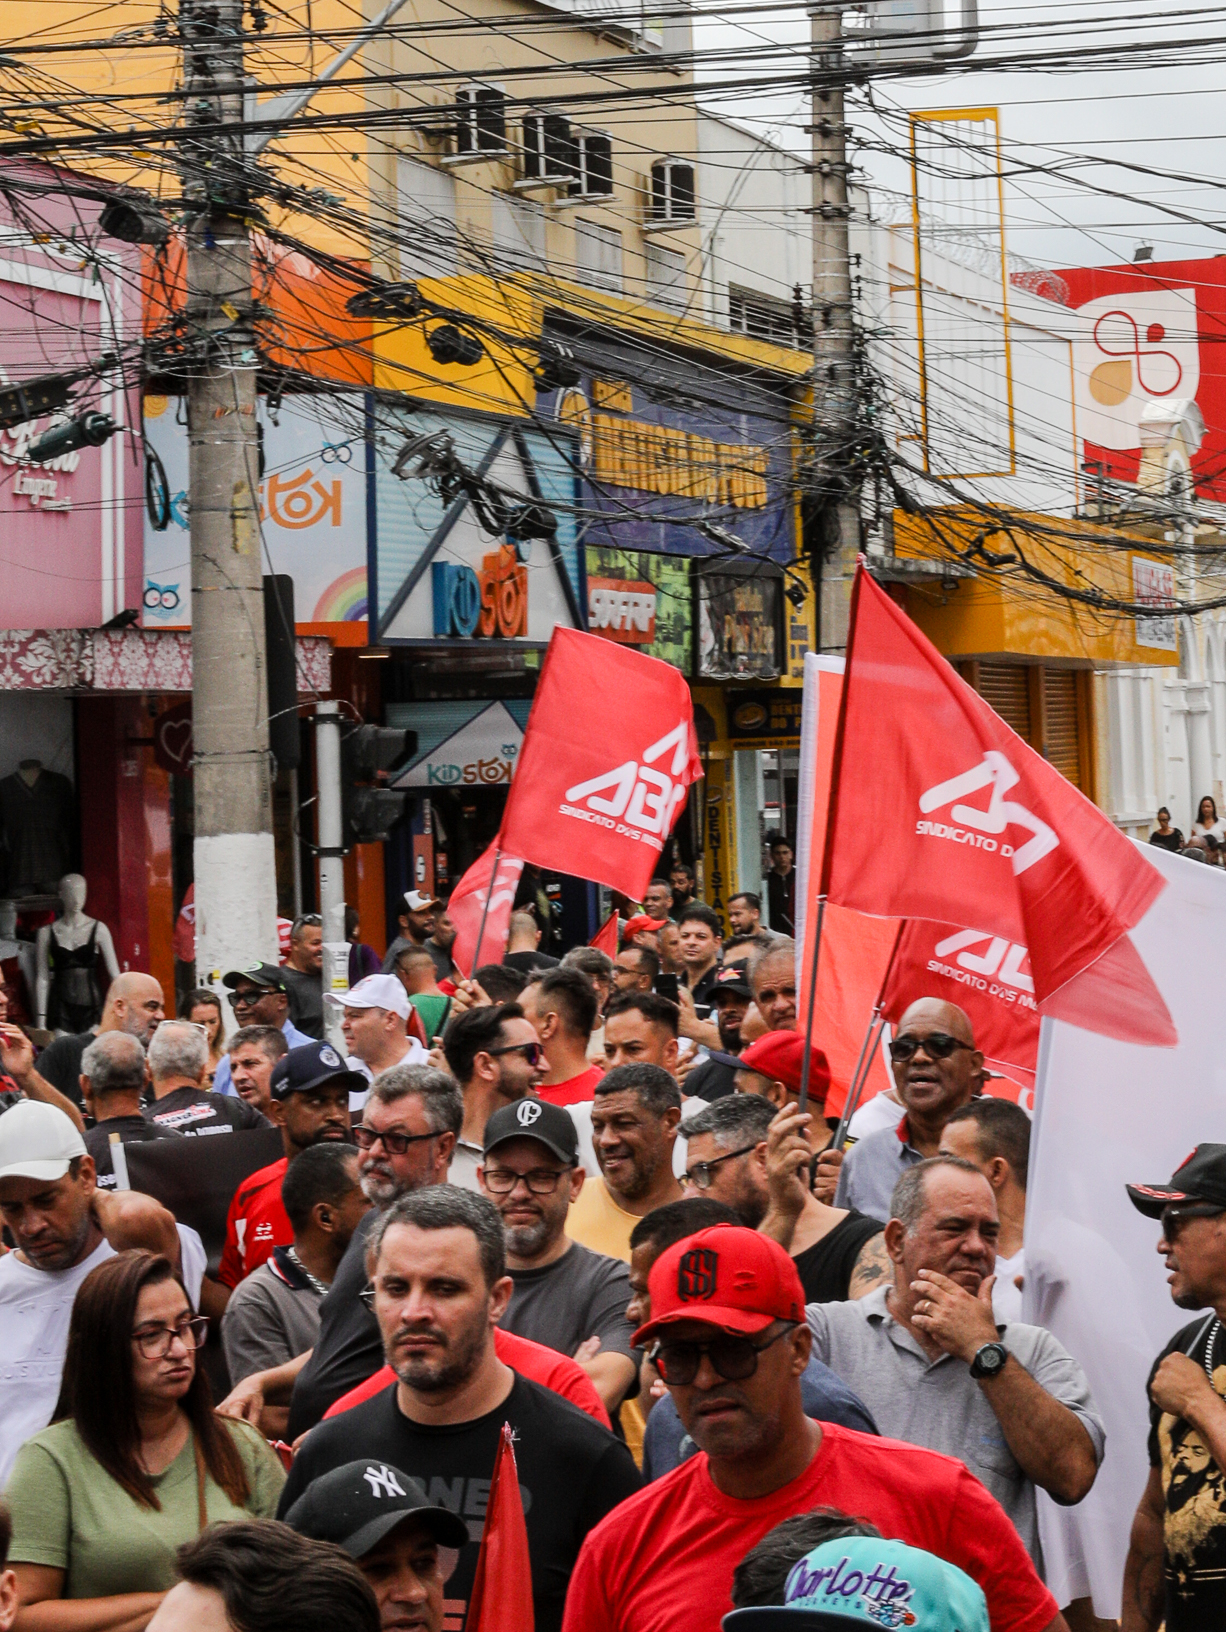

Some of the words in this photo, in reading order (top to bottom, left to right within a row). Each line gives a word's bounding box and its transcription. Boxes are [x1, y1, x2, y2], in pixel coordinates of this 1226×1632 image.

[558, 804, 616, 829] SINDICATO
[915, 820, 998, 852] SINDICATO
[927, 960, 987, 990] SINDICATO
